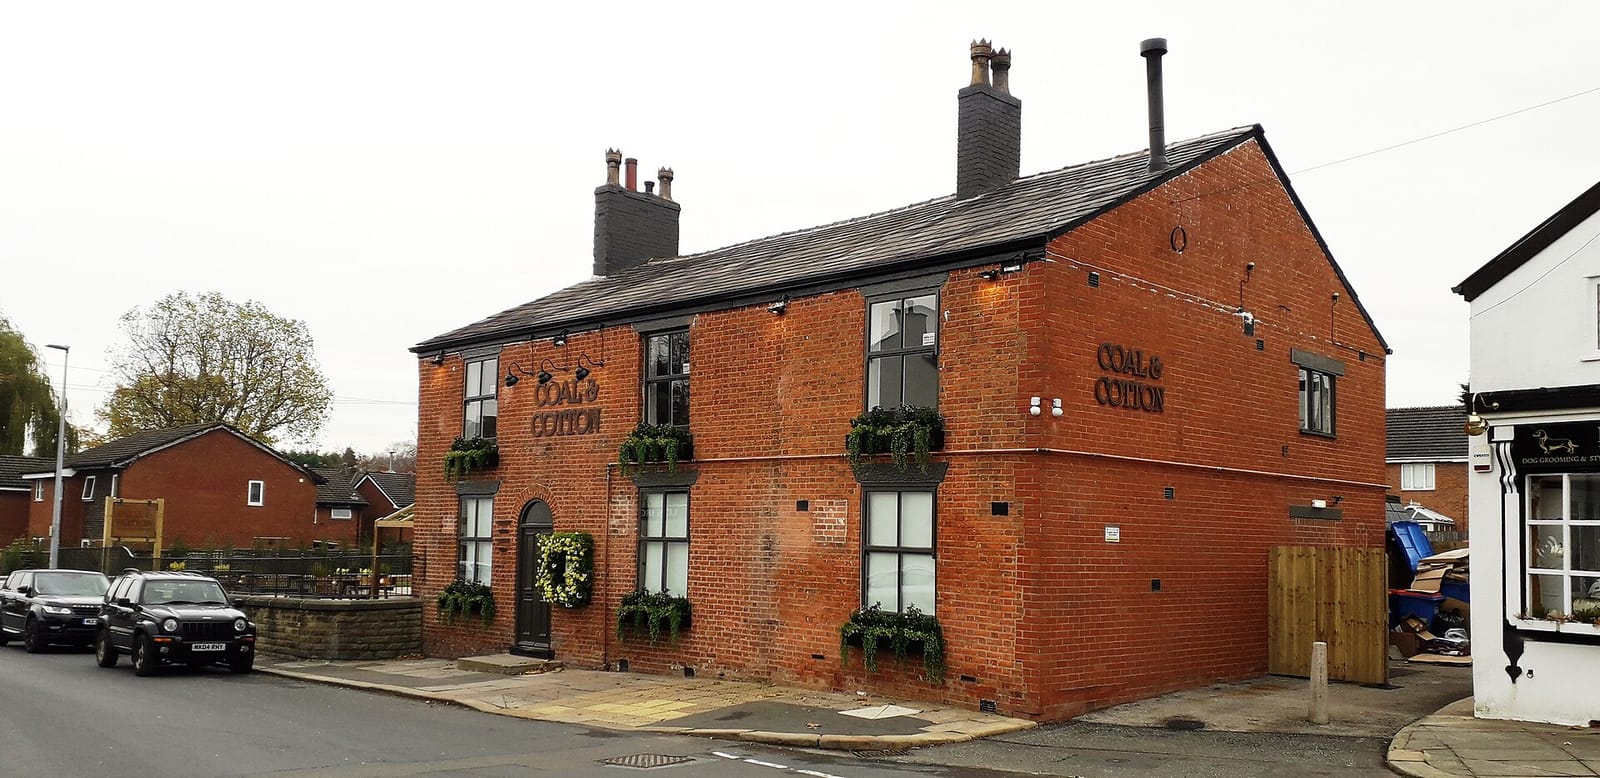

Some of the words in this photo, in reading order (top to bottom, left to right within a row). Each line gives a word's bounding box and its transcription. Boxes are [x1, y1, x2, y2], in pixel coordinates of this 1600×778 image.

[1099, 343, 1147, 376] COAL
[1150, 356, 1163, 379] &
[535, 379, 582, 407] COAL
[585, 379, 599, 402] &
[1096, 376, 1165, 412] COTTON
[533, 408, 601, 437] COTTON
